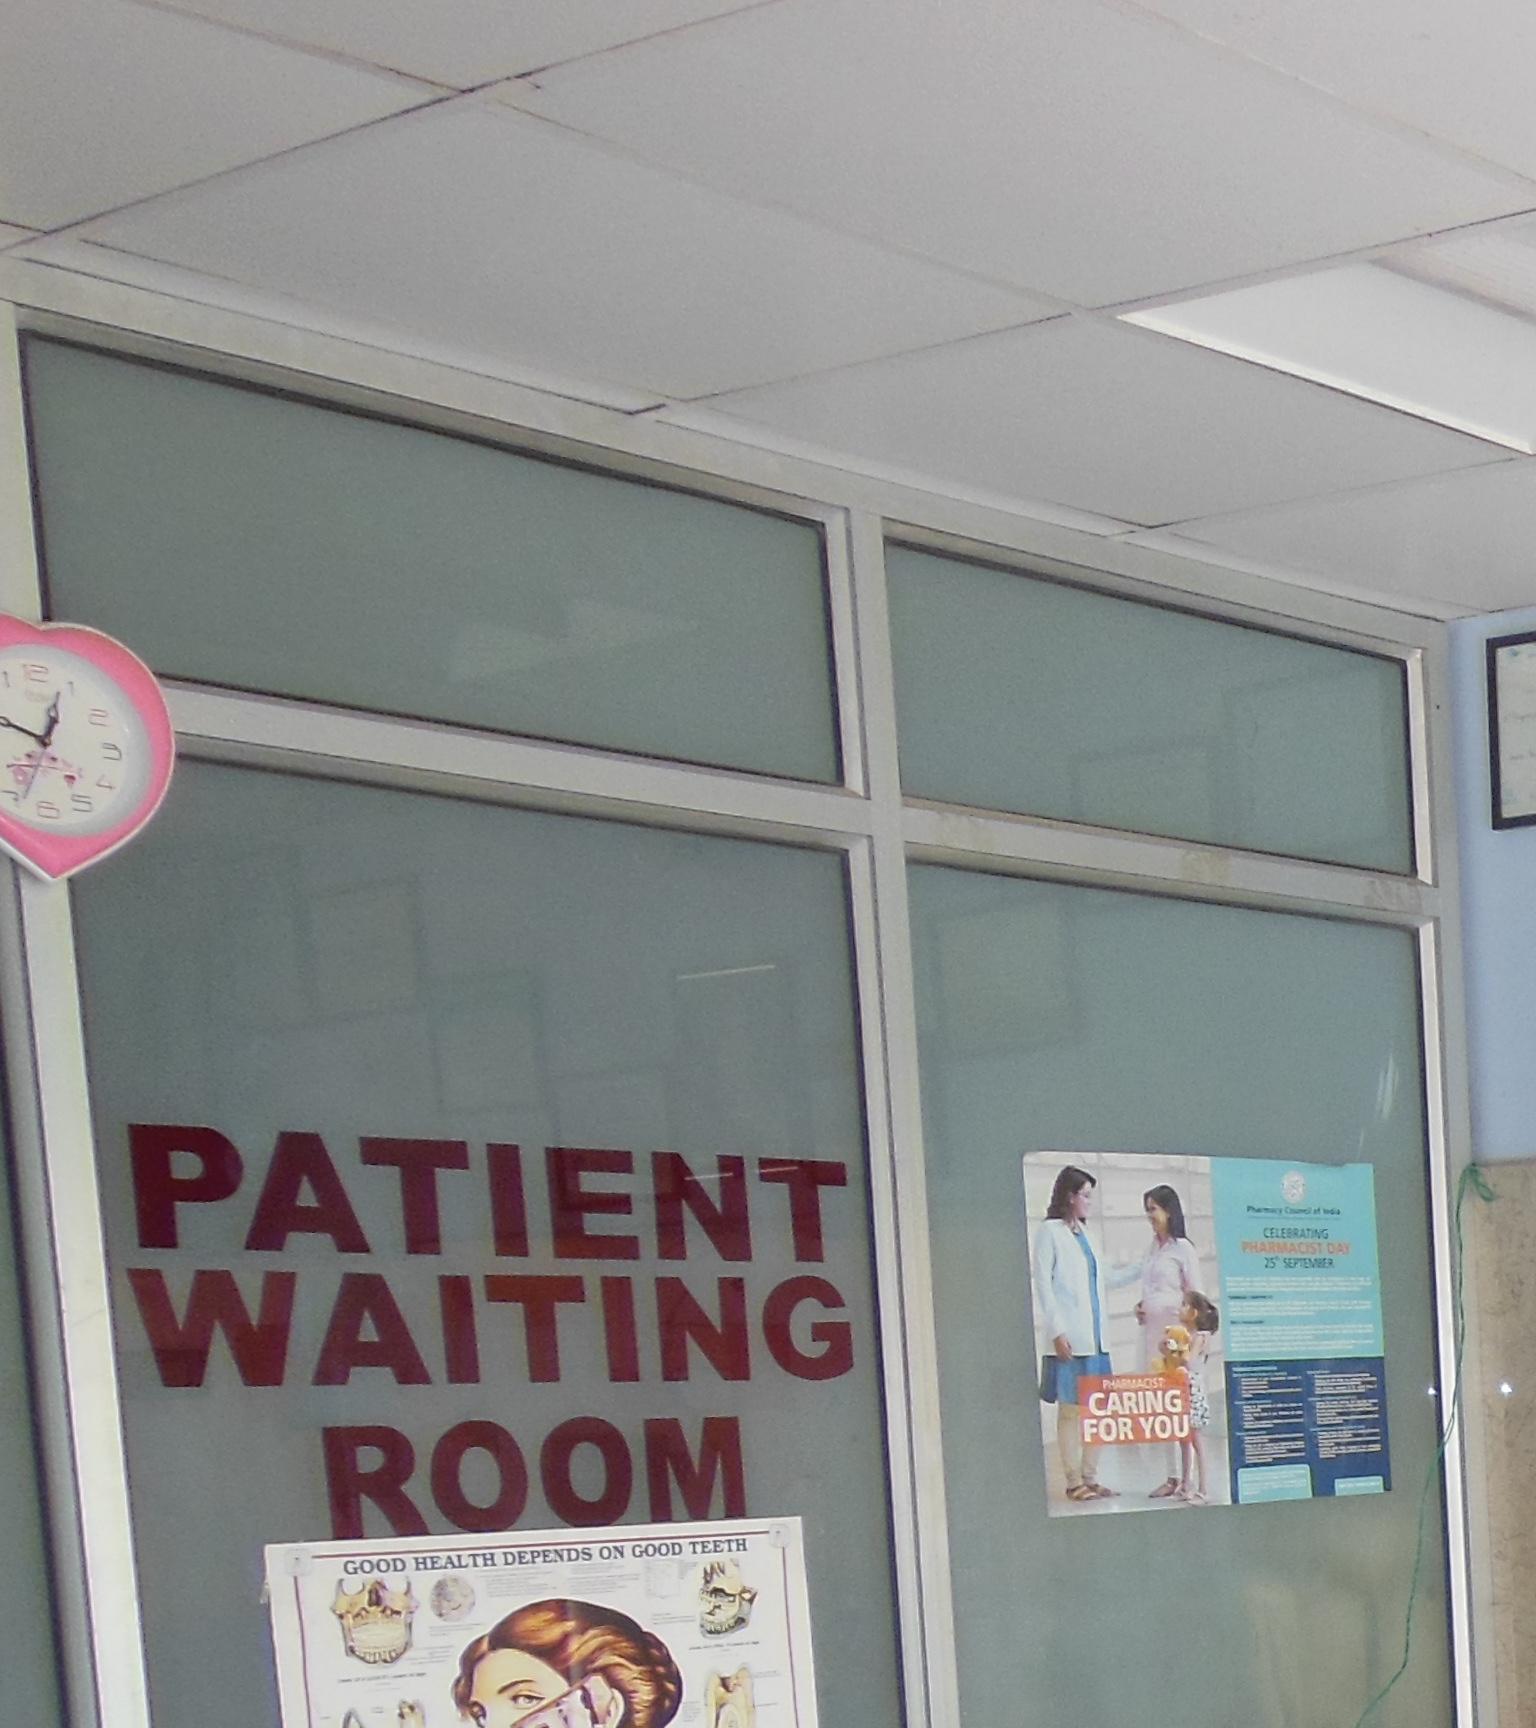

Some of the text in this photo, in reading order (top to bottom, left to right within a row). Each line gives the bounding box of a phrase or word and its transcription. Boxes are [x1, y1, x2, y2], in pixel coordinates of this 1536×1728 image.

[127, 1124, 847, 1263] PATIENT
[1242, 1241, 1350, 1254] PHARMACIST DAY
[1263, 1227, 1329, 1240] CELEBRATING
[1283, 1257, 1335, 1269] SEPTEMBER
[127, 1267, 855, 1388] WAITING
[1089, 1389, 1182, 1416] CARING
[1083, 1414, 1189, 1442] FOR YOU
[322, 1415, 745, 1540] ROOM
[343, 1538, 748, 1576] GOOD HEALTH DEPENDS ON GOOD TEETH
